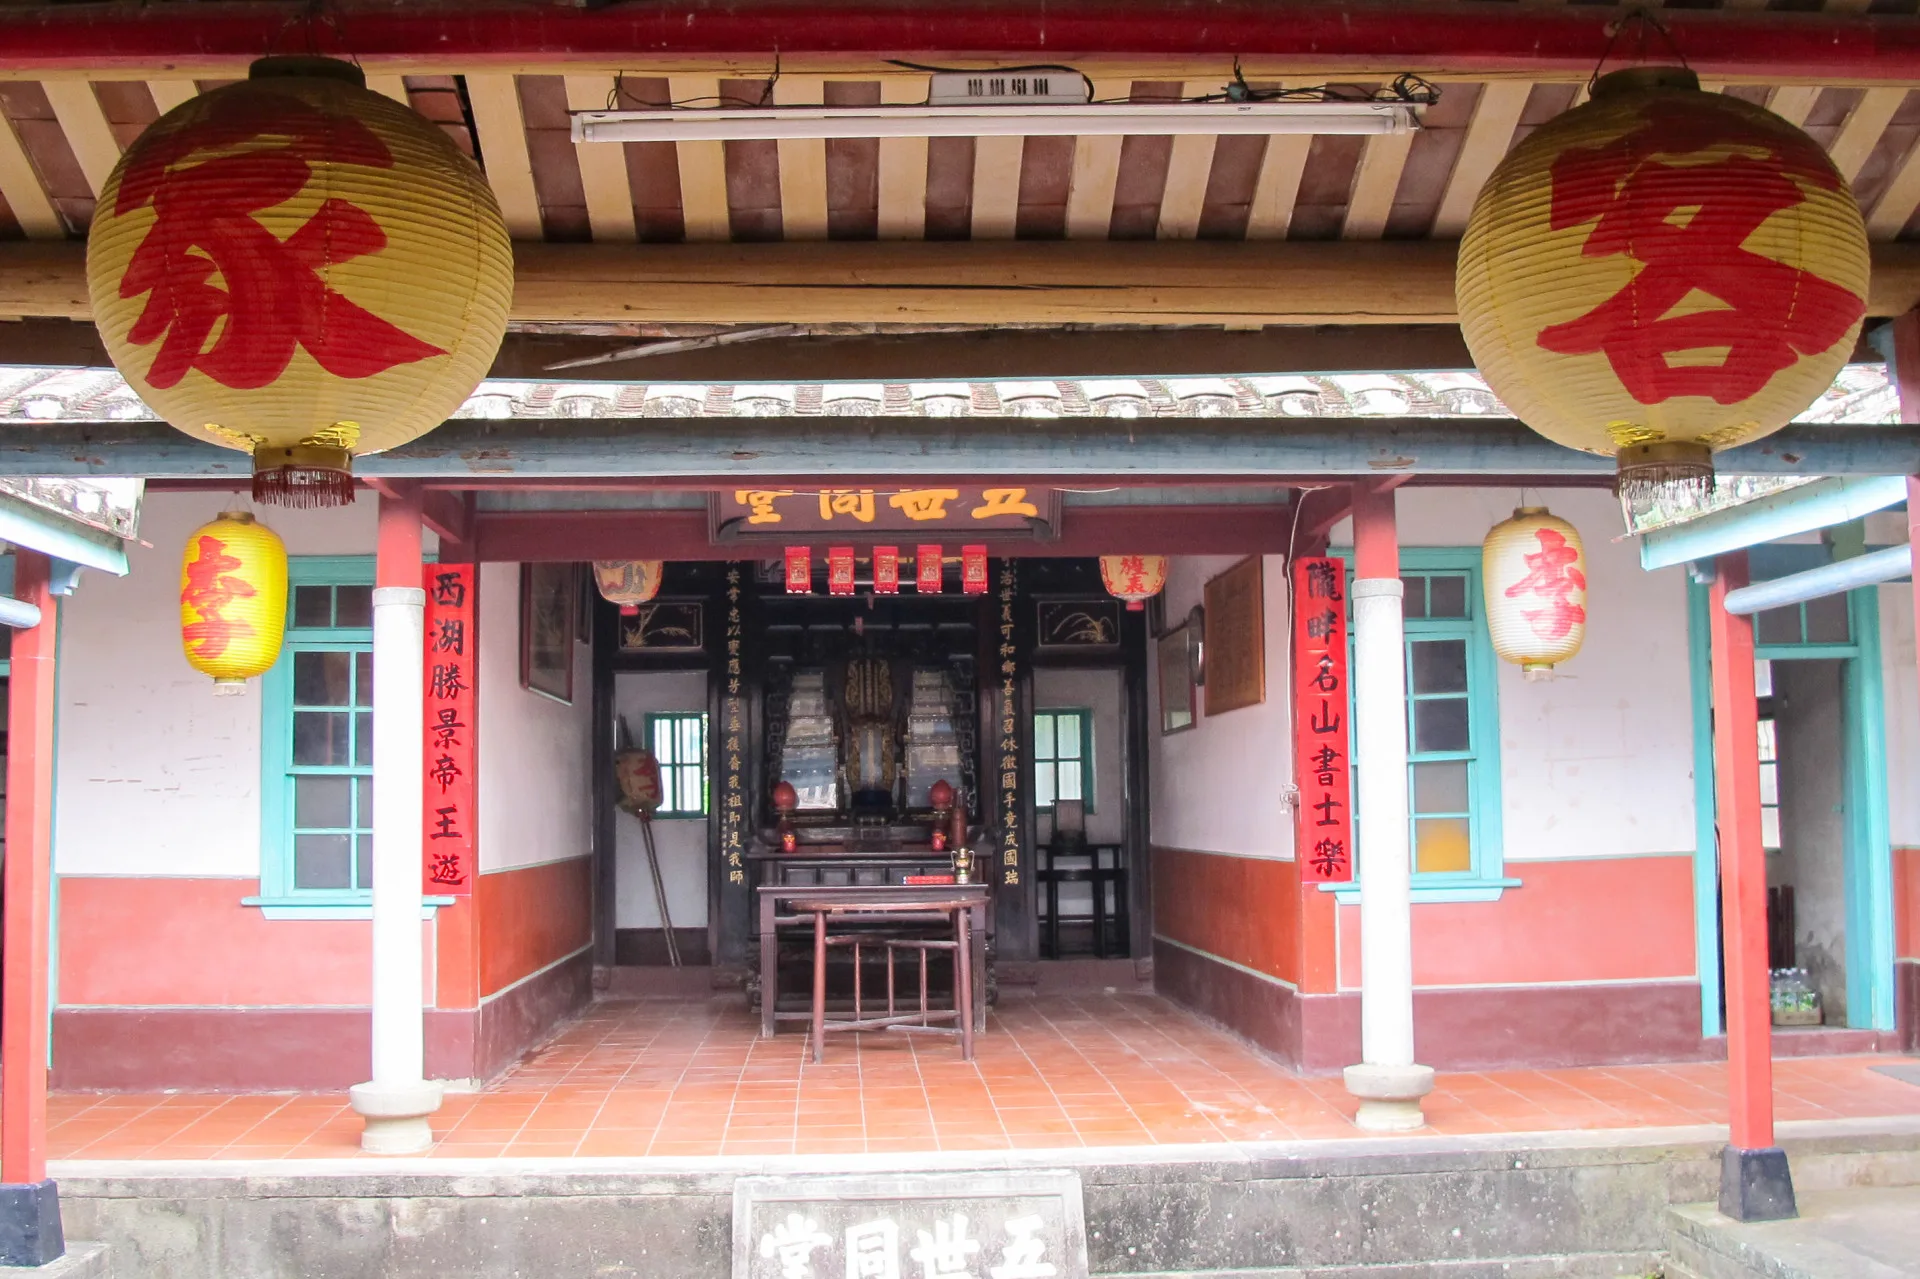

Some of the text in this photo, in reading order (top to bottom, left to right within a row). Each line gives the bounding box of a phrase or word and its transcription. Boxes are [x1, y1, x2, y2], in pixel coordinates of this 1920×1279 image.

[114, 95, 450, 389] 家
[1536, 98, 1867, 405] 客
[428, 572, 469, 885] 西湖勝景帝王遊
[1305, 561, 1347, 877] 隴畔名山書士樂
[760, 1212, 1077, 1279] 五世同堂
